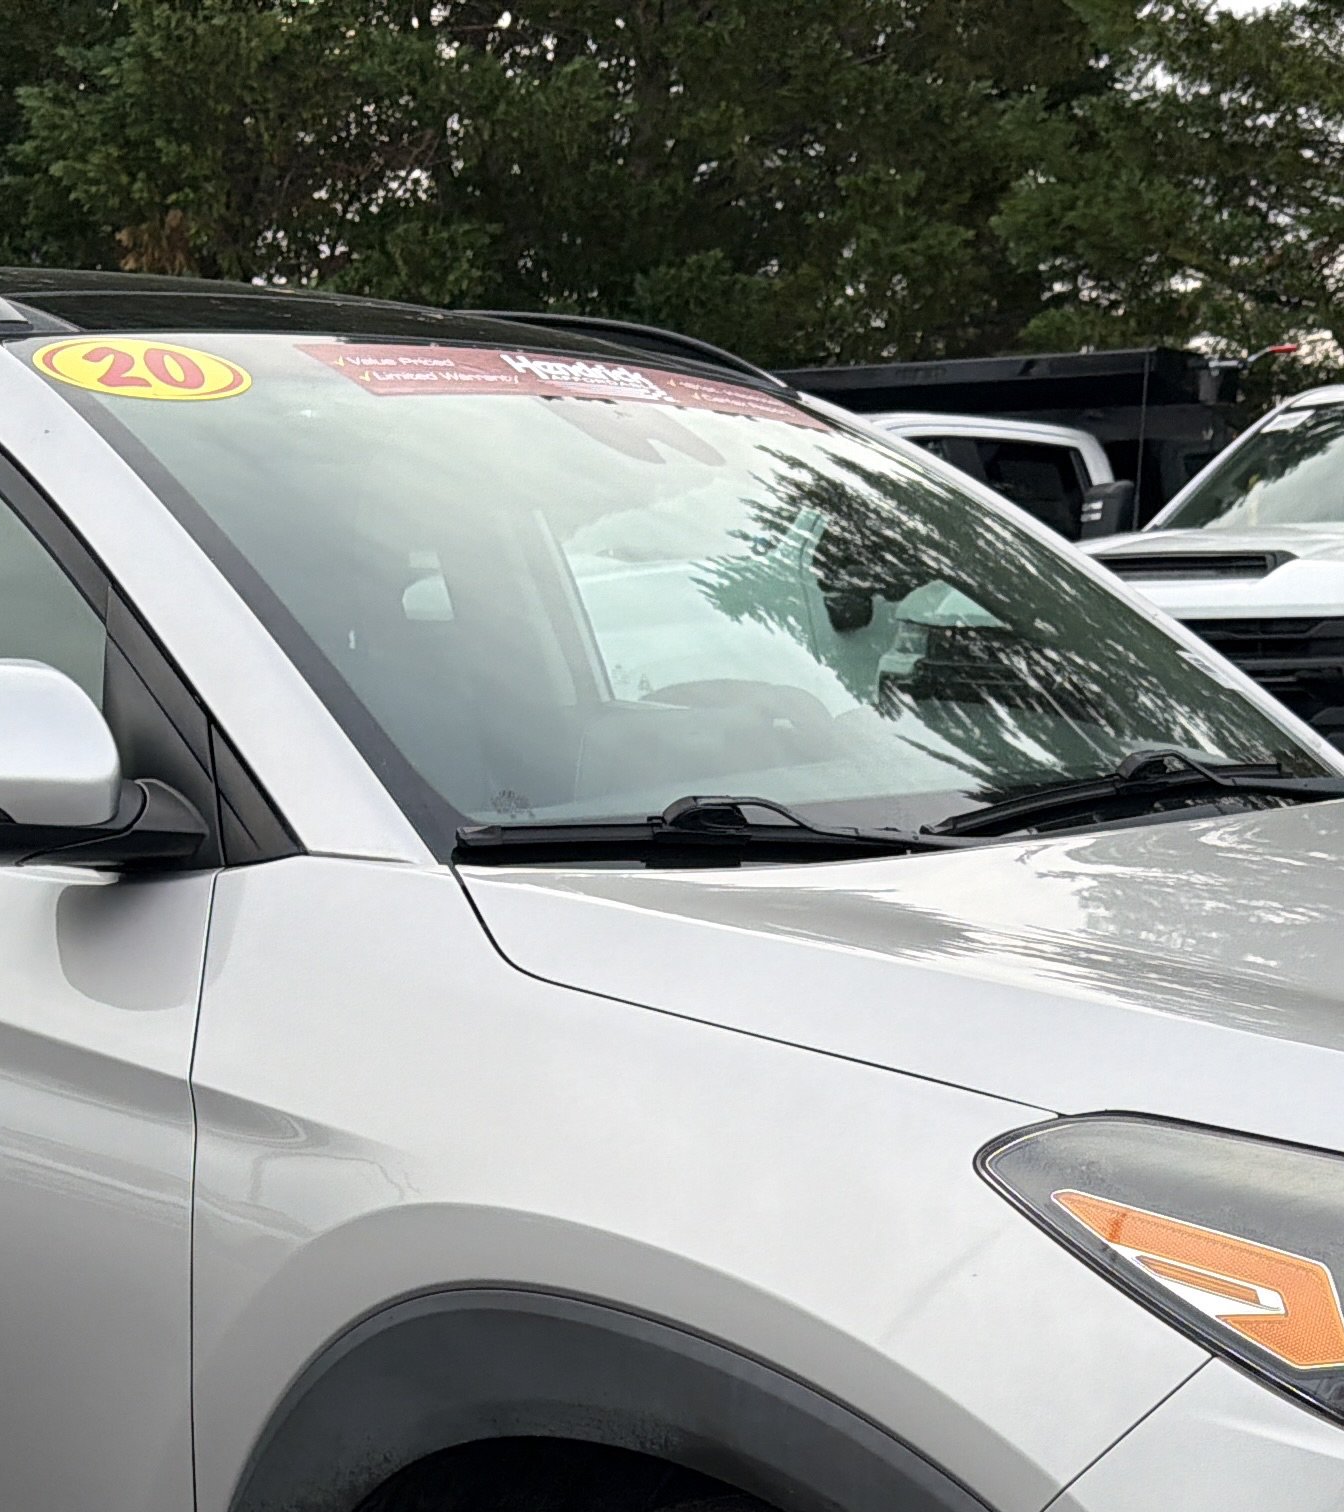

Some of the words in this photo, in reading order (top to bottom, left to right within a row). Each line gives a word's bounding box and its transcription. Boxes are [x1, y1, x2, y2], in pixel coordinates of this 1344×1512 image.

[81, 346, 206, 390] 20
[345, 356, 397, 367] Value
[398, 356, 456, 368] Priced
[499, 354, 660, 388] Hendrick
[372, 371, 438, 382] Limited
[438, 371, 520, 385] Warranty
